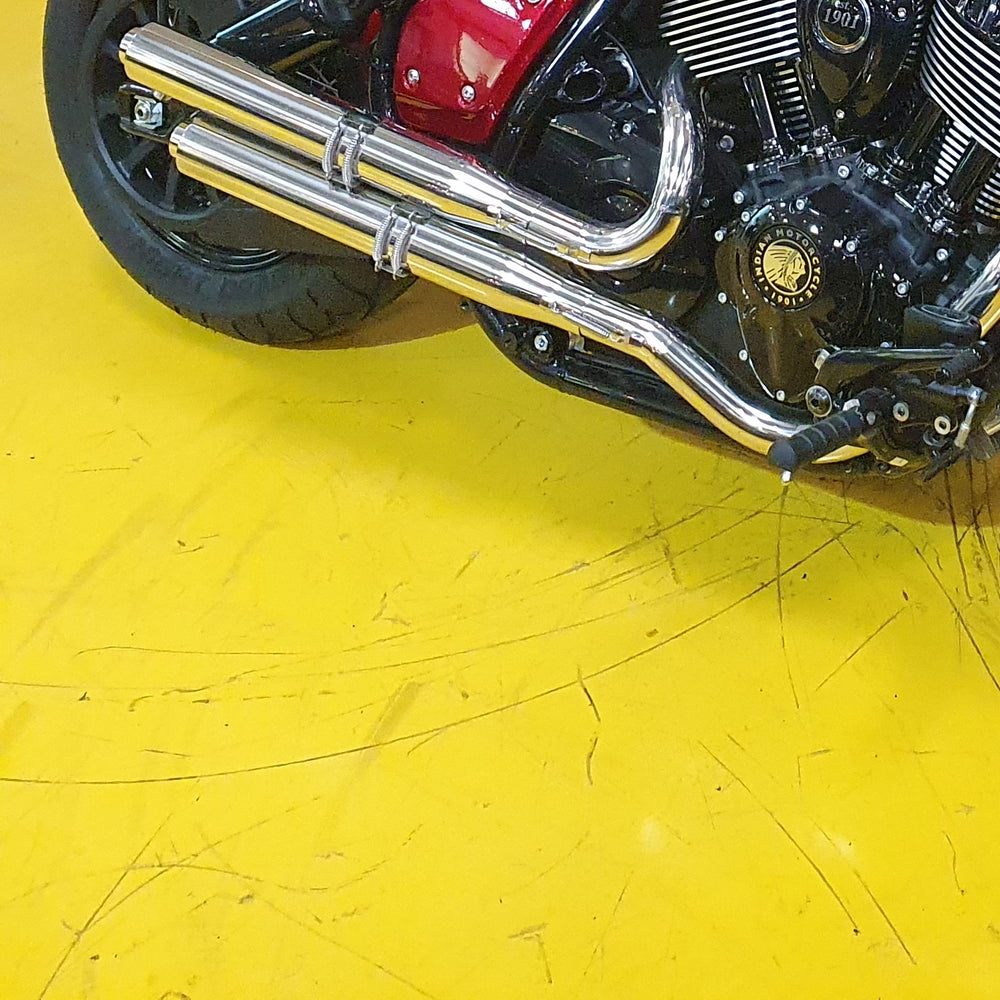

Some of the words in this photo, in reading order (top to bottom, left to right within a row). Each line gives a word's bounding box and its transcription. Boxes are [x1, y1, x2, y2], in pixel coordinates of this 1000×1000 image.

[823, 8, 860, 29] 1901
[754, 233, 772, 283] INDIAN
[776, 228, 821, 299] MOTORCYCLE
